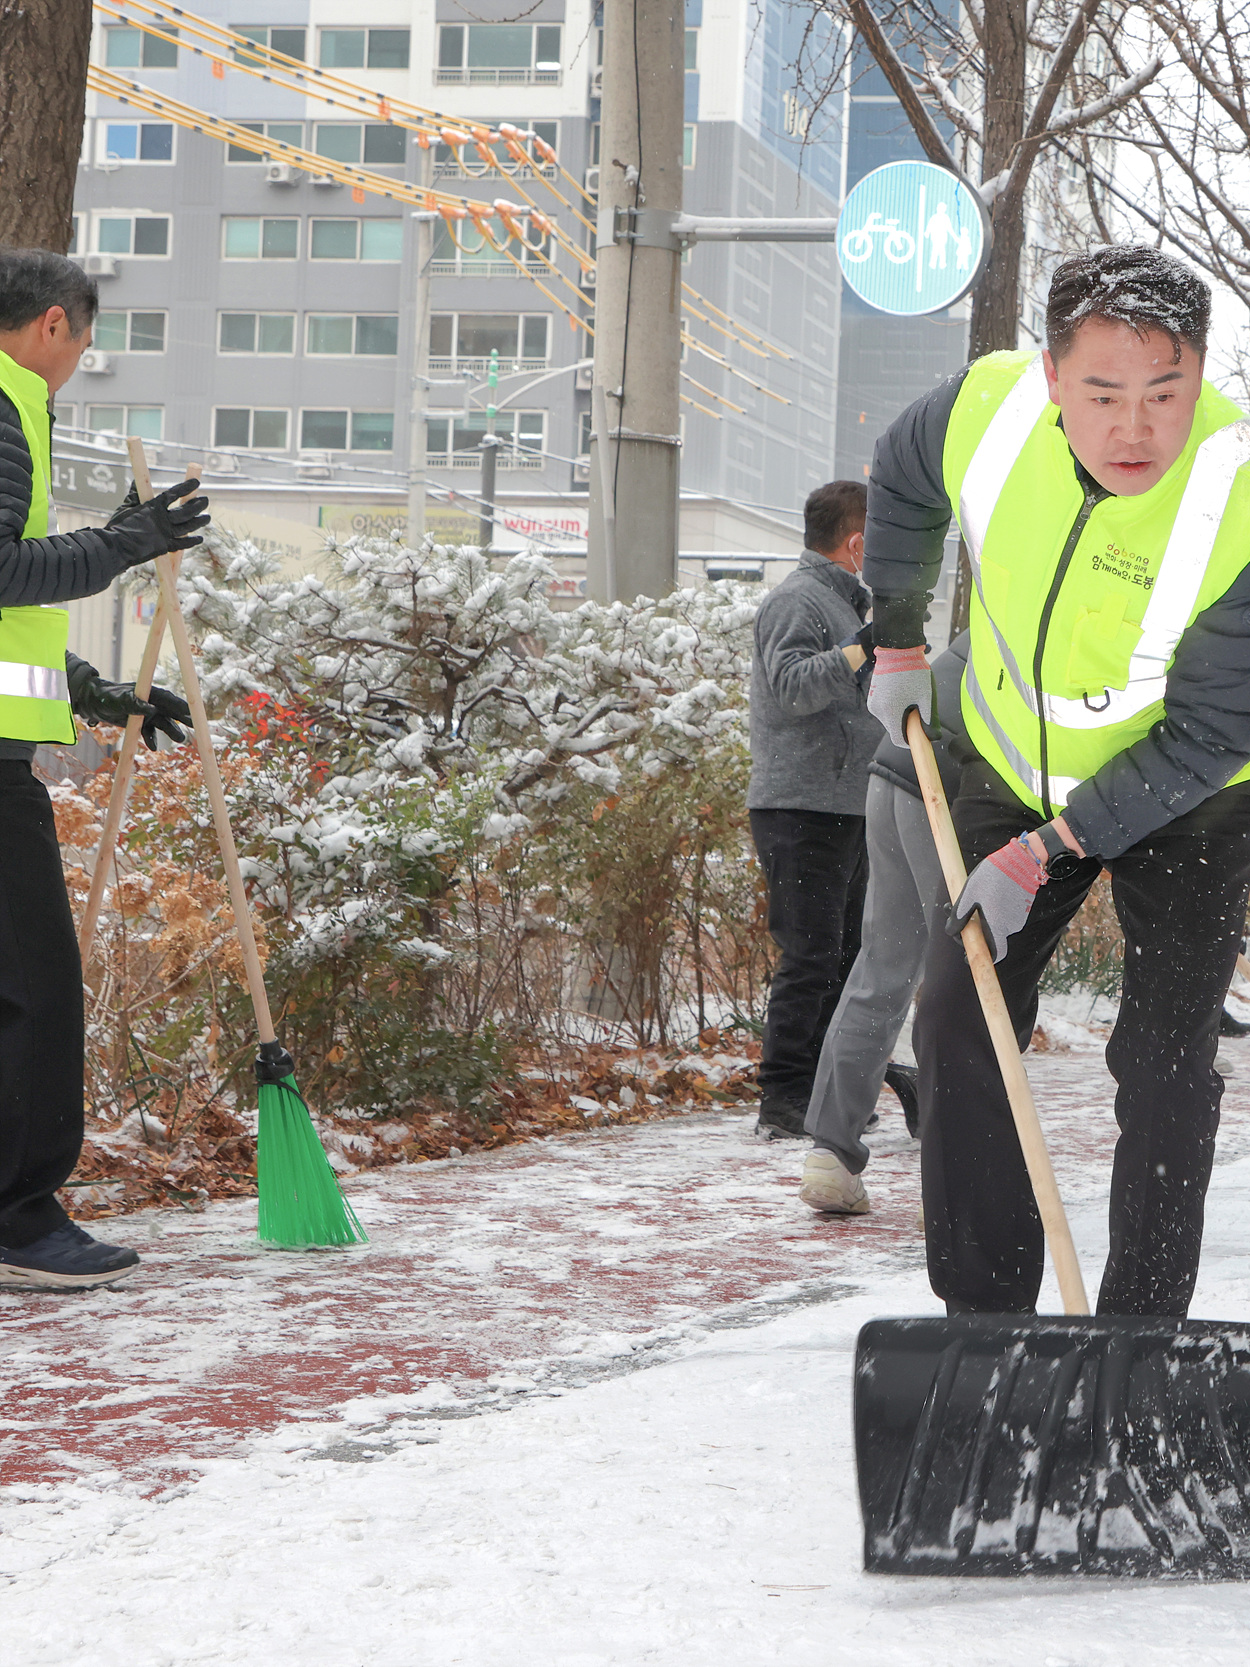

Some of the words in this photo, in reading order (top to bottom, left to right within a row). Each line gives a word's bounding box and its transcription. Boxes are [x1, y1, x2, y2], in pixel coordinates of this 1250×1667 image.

[1107, 543, 1150, 566] dobong
[1091, 555, 1131, 582] 함께해요!
[1131, 574, 1155, 590] 도봉
